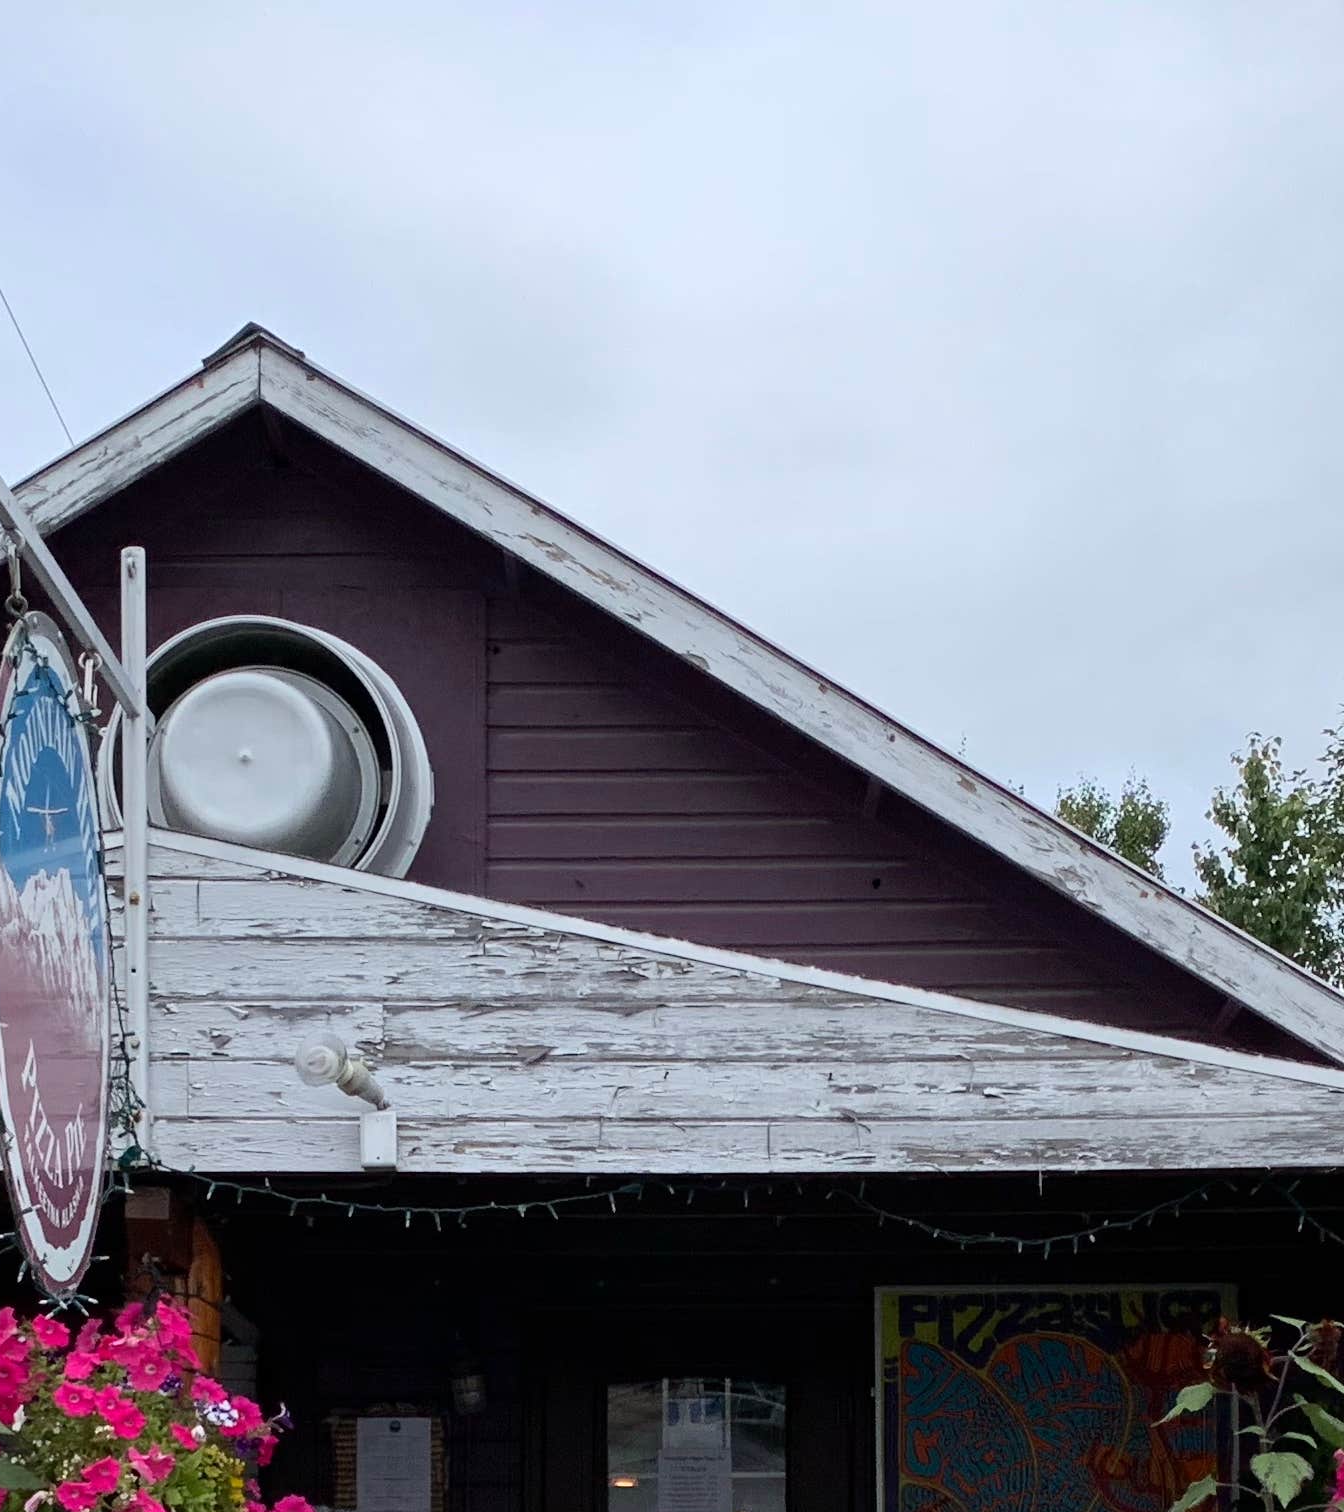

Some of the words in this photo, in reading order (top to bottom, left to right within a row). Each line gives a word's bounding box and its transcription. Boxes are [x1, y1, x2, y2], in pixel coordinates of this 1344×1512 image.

[6, 696, 77, 841] MOUNTAIN
[21, 1039, 64, 1189] PIZZA
[64, 1103, 88, 1187] PIE
